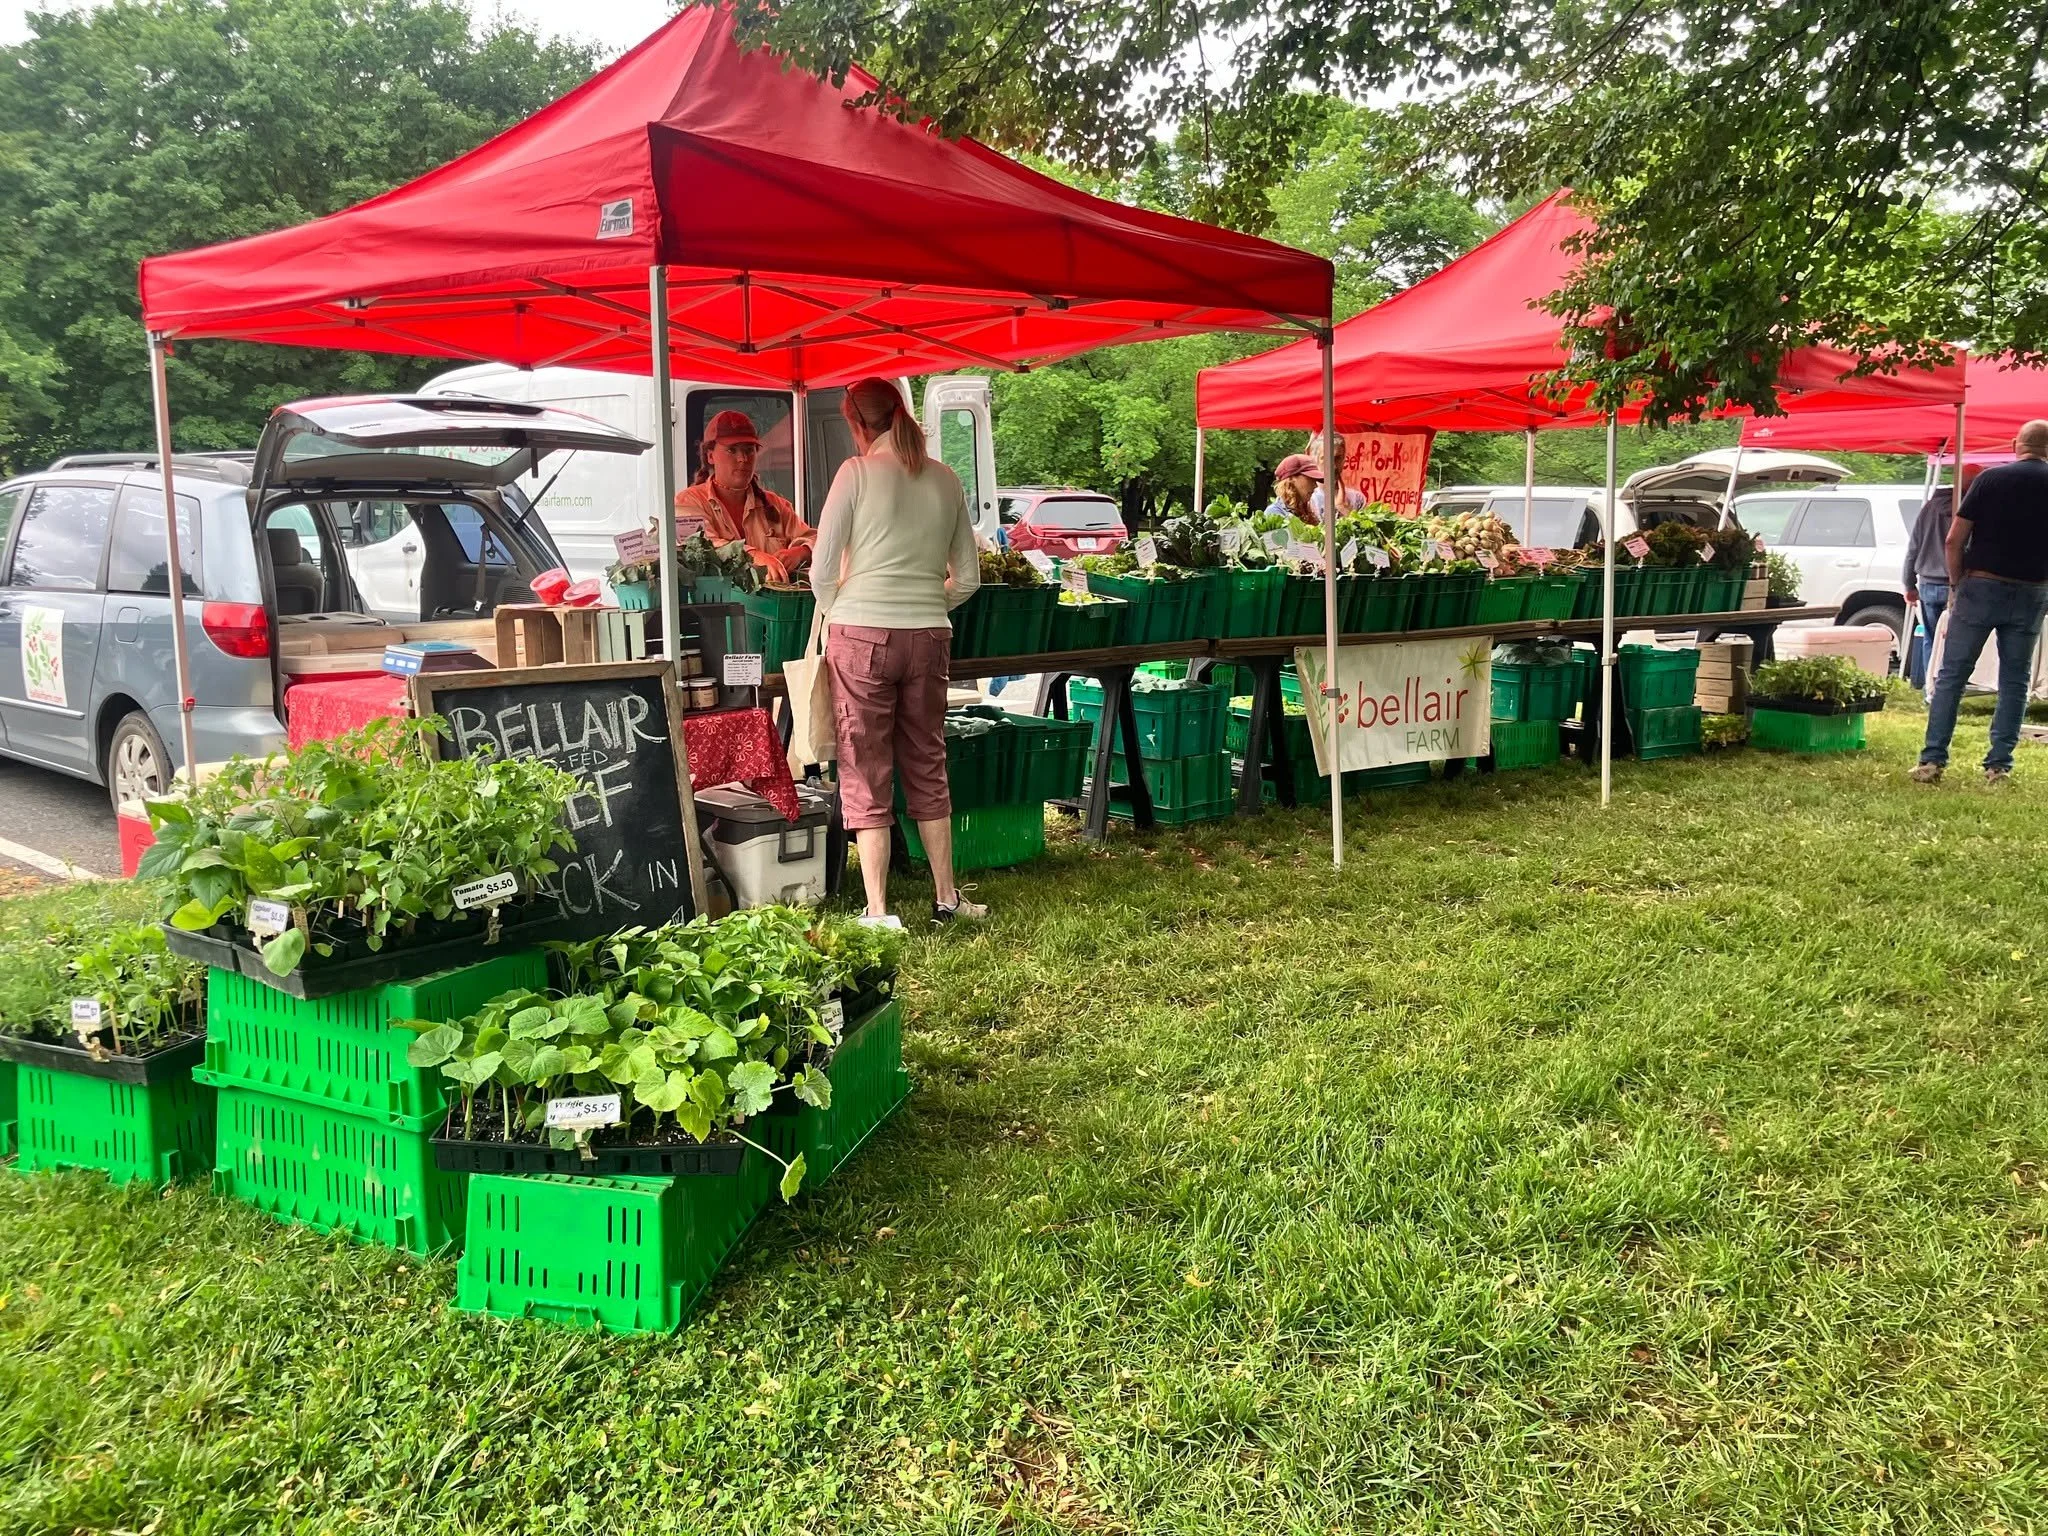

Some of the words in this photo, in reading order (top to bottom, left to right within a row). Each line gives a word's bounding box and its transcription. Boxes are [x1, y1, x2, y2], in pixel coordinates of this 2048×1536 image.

[1342, 441, 1365, 471] eef,
[1357, 677, 1469, 729] bellair
[449, 694, 667, 767] BELLAIR
[1405, 727, 1460, 755] FARM
[565, 759, 633, 831] EF
[453, 883, 484, 896] Tomato
[486, 878, 513, 894] $5.50
[648, 858, 679, 892] IN
[463, 893, 488, 905] Plants
[583, 1102, 615, 1114] $5.50
